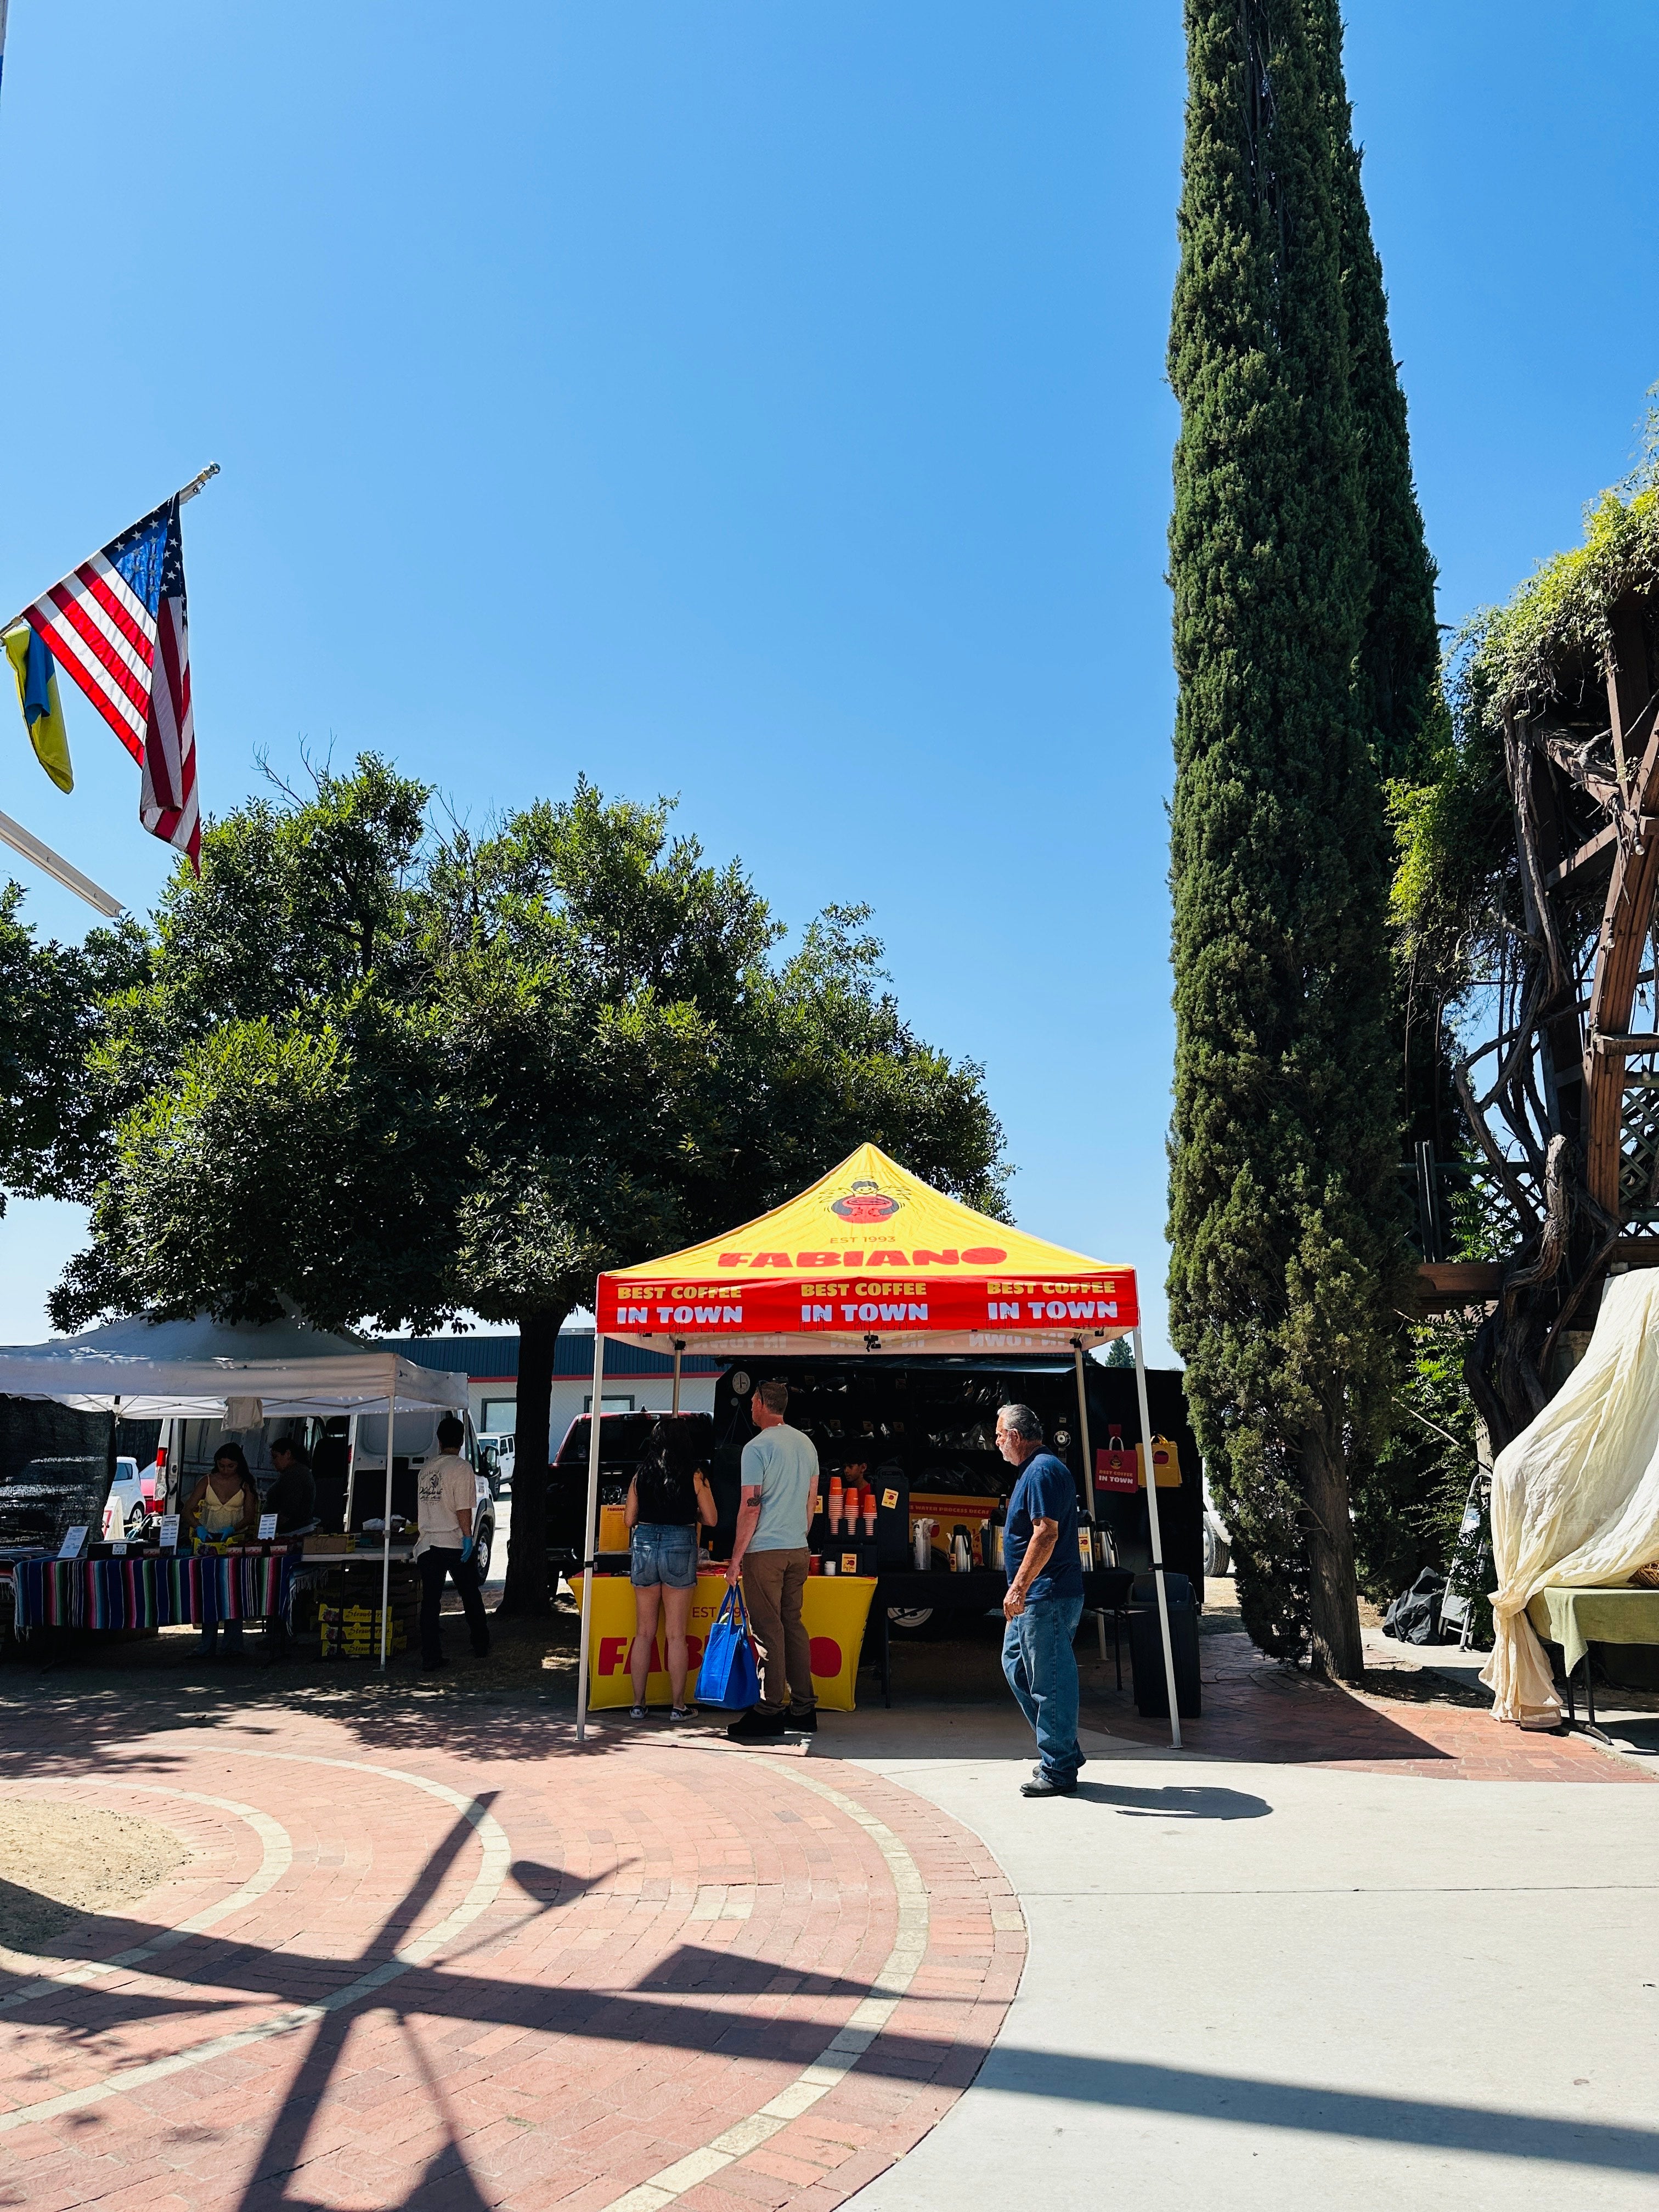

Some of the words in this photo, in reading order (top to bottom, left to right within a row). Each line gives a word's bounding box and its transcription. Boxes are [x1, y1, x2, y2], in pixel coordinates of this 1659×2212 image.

[718, 1247, 1007, 1267] FABIANO
[618, 1286, 665, 1299] BEST
[671, 1286, 742, 1299] COFFEE
[801, 1284, 849, 1297] BEST
[855, 1283, 927, 1296] COFFEE
[987, 1282, 1036, 1295] BEST
[1042, 1282, 1116, 1294] COFFEE
[617, 1307, 648, 1324] IN
[657, 1306, 743, 1323] TOWN
[802, 1305, 833, 1322] IN
[841, 1304, 928, 1322] TOWN
[988, 1302, 1020, 1320] IN
[1028, 1301, 1118, 1319] TOWN
[1109, 1476, 1133, 1484] TOWN
[692, 1607, 716, 1618] EST
